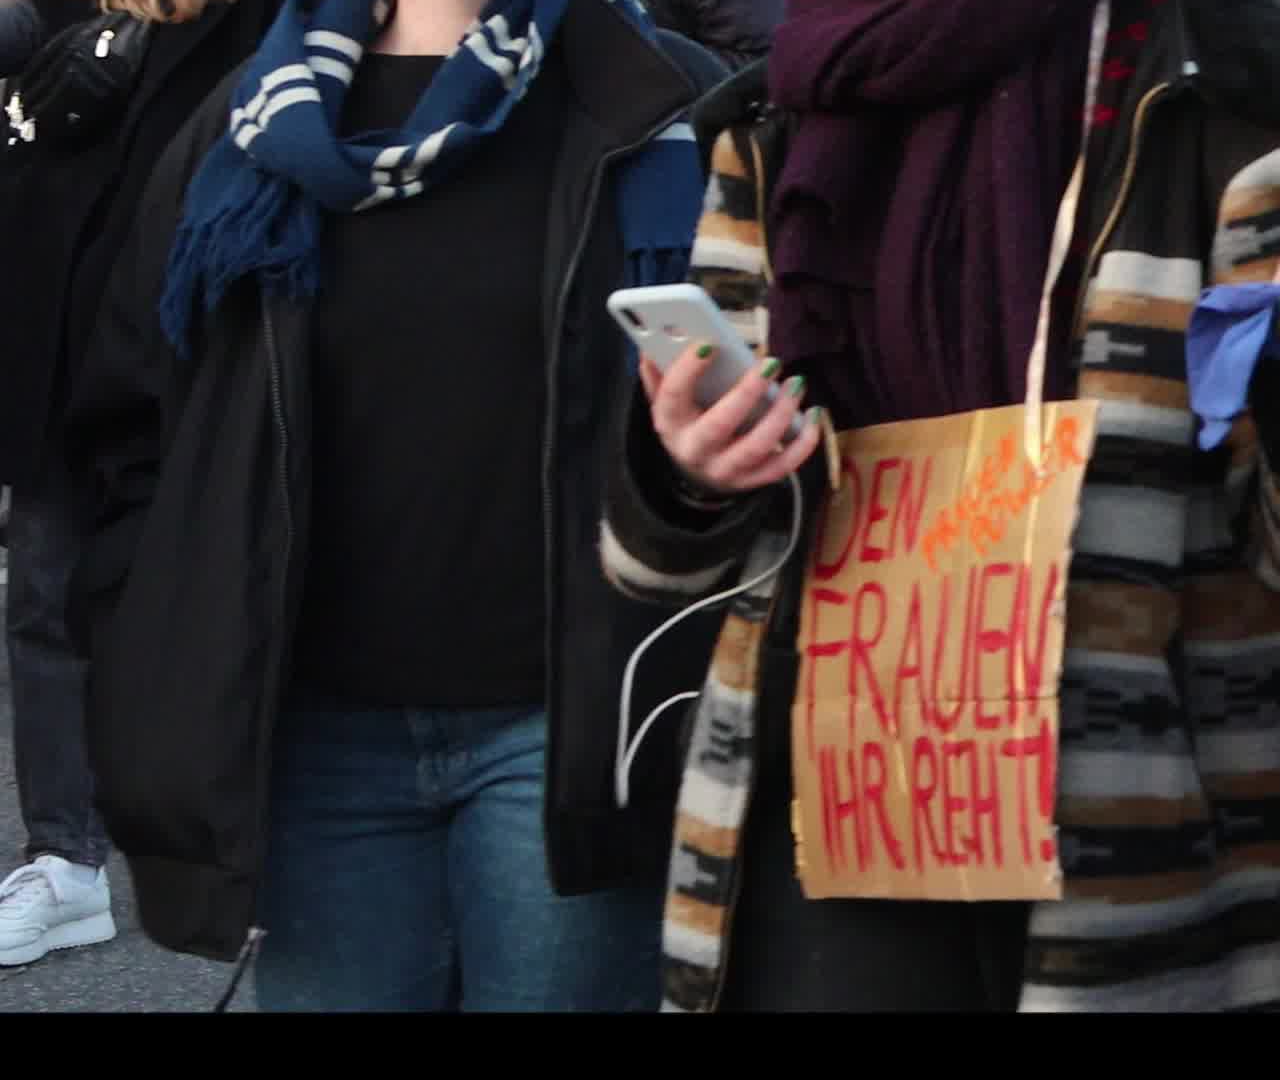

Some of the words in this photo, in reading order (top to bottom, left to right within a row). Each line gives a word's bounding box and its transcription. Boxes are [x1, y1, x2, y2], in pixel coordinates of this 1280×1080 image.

[813, 456, 932, 580] DEN
[806, 562, 1059, 761] FRAUEN
[818, 741, 906, 874] IHR
